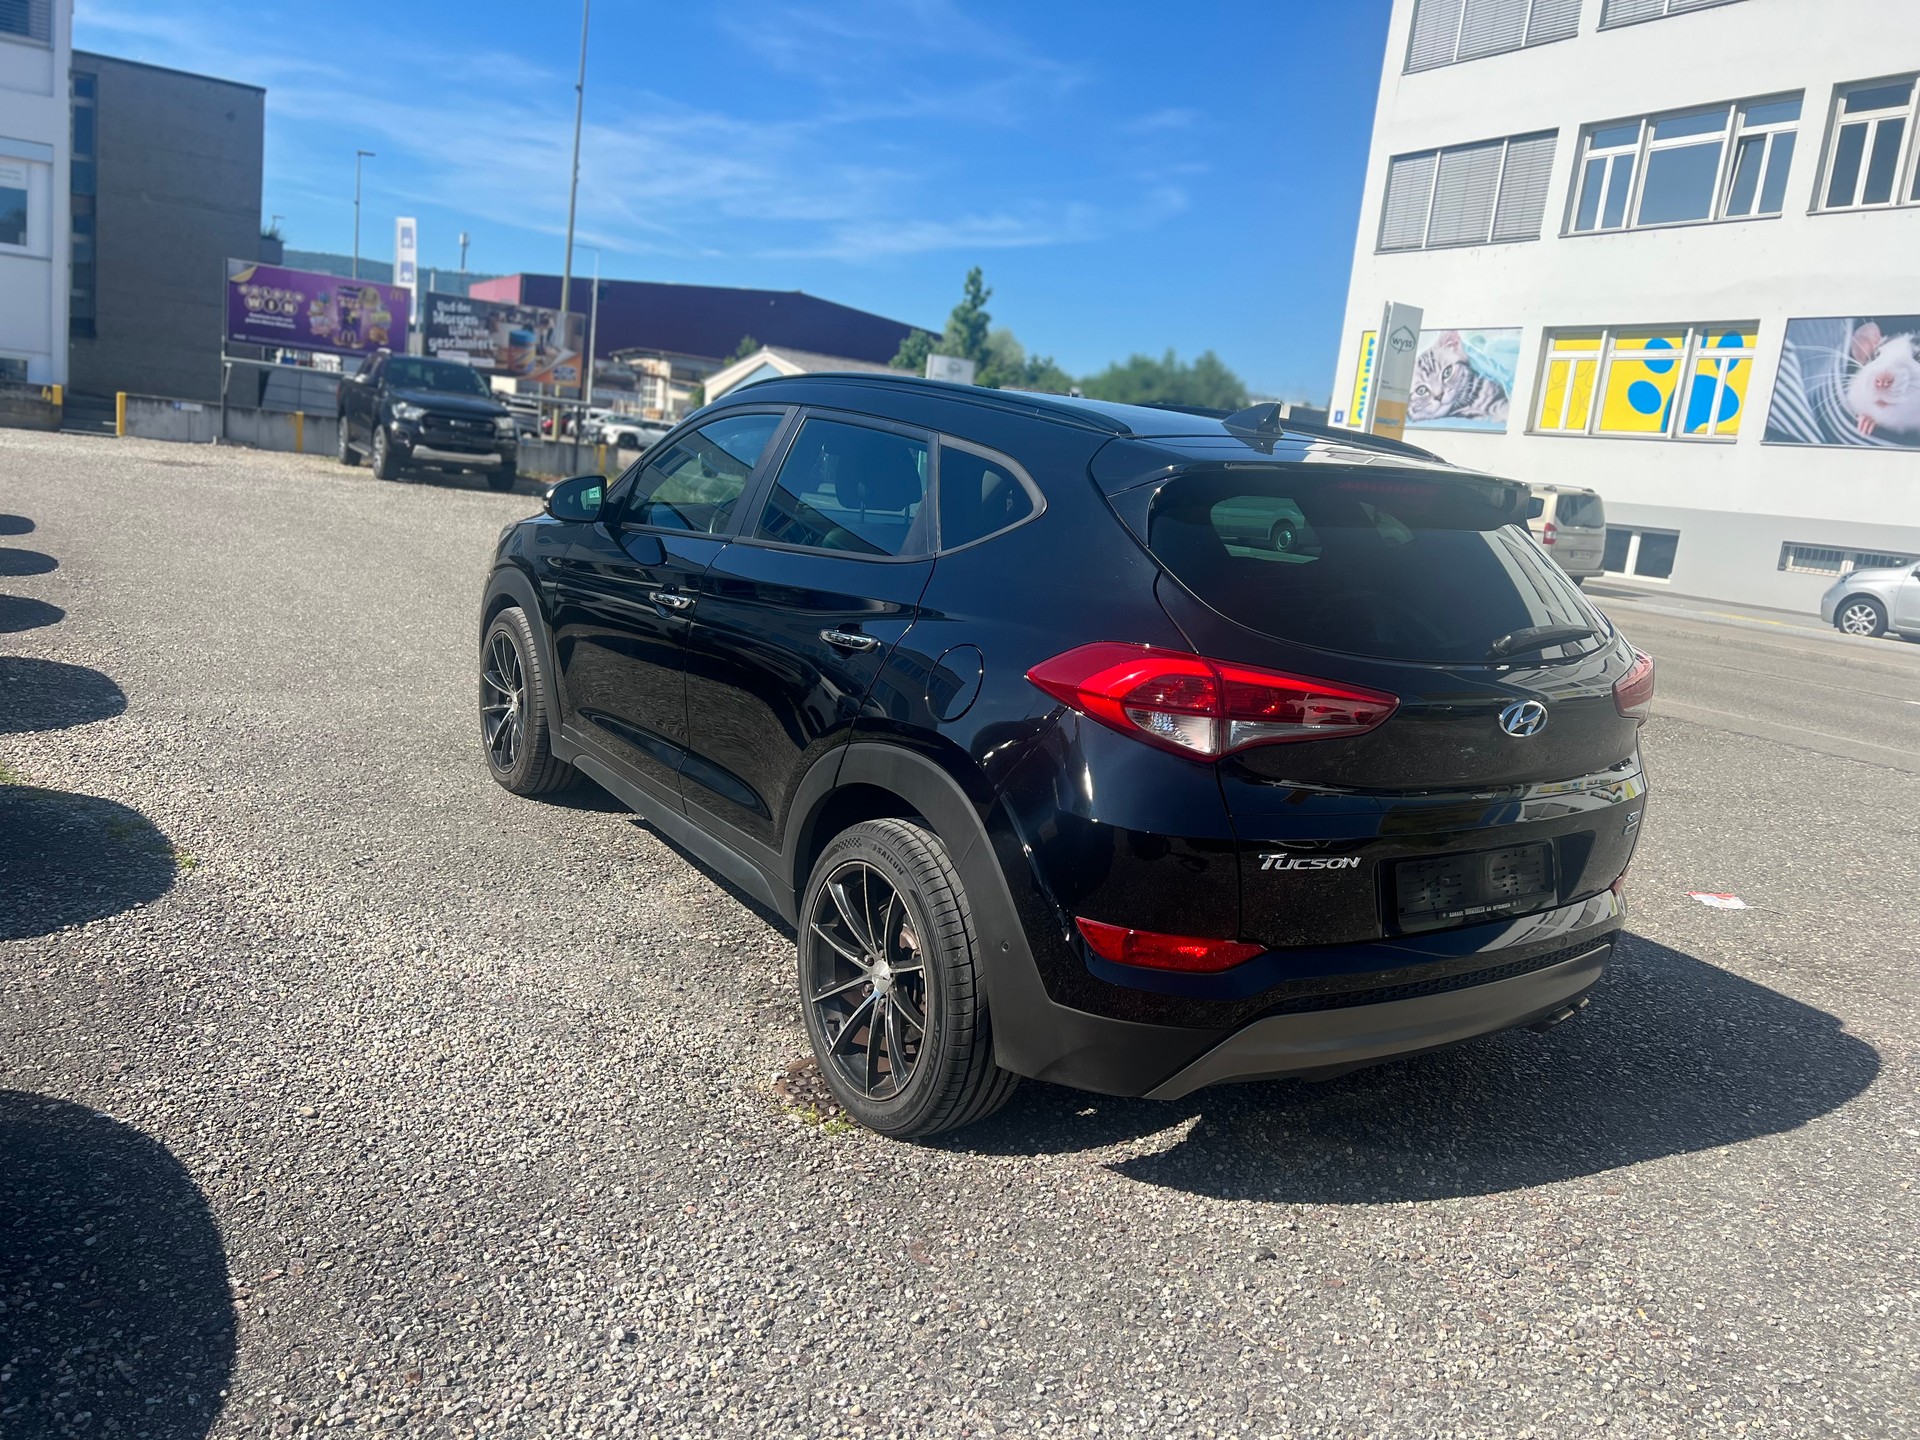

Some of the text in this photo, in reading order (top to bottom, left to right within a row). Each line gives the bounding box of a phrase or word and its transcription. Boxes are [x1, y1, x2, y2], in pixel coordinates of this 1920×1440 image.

[437, 301, 471, 313] Und der
[433, 311, 478, 328] Morgen
[876, 847, 904, 876] SAILUN
[1258, 853, 1361, 870] TUCSON
